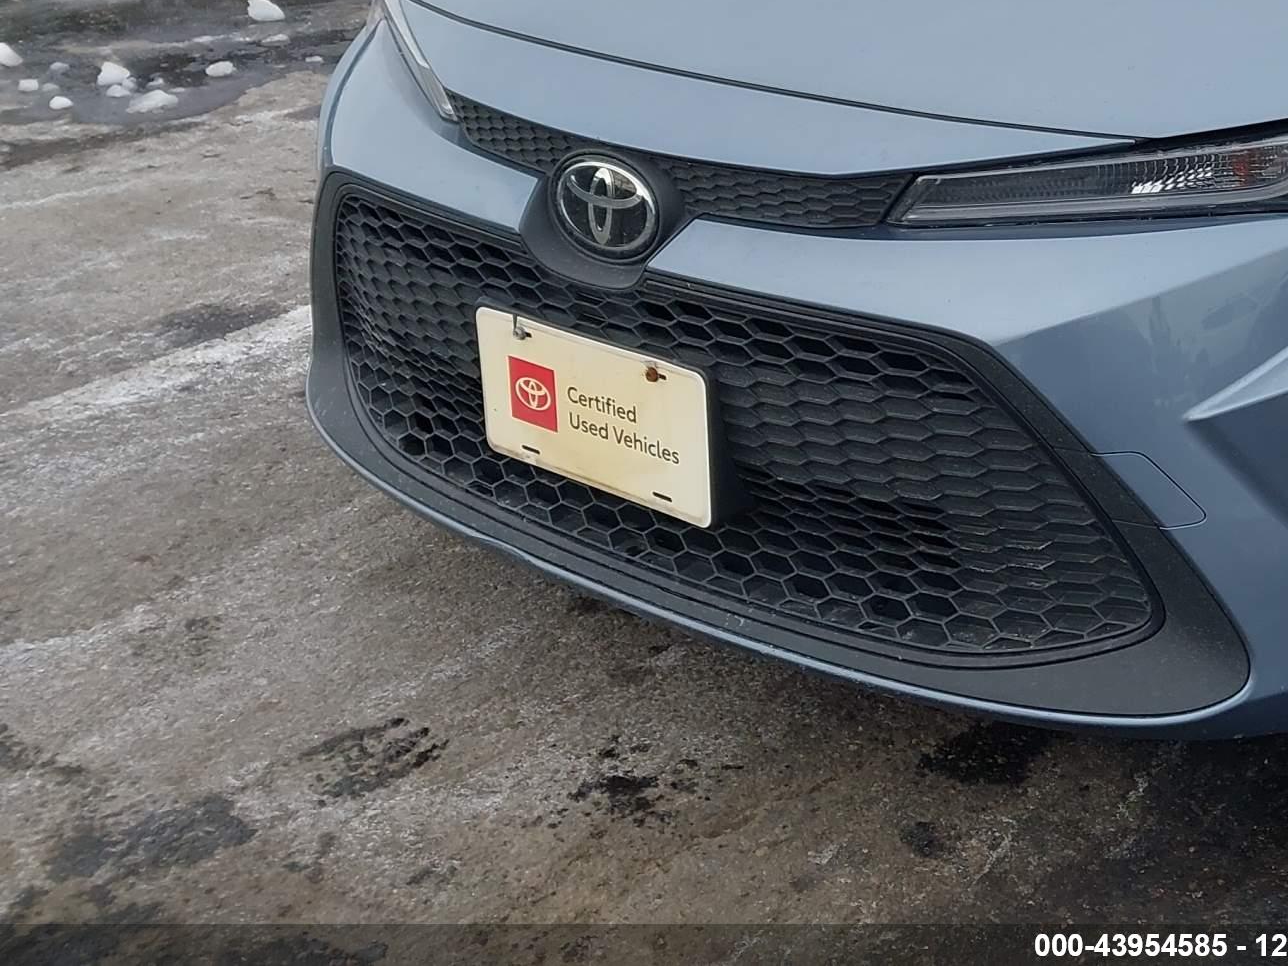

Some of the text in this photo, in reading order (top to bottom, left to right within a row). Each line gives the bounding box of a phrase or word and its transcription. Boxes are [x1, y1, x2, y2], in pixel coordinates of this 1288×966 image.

[567, 386, 637, 424] Certified
[568, 412, 680, 465] Used Vehicles
